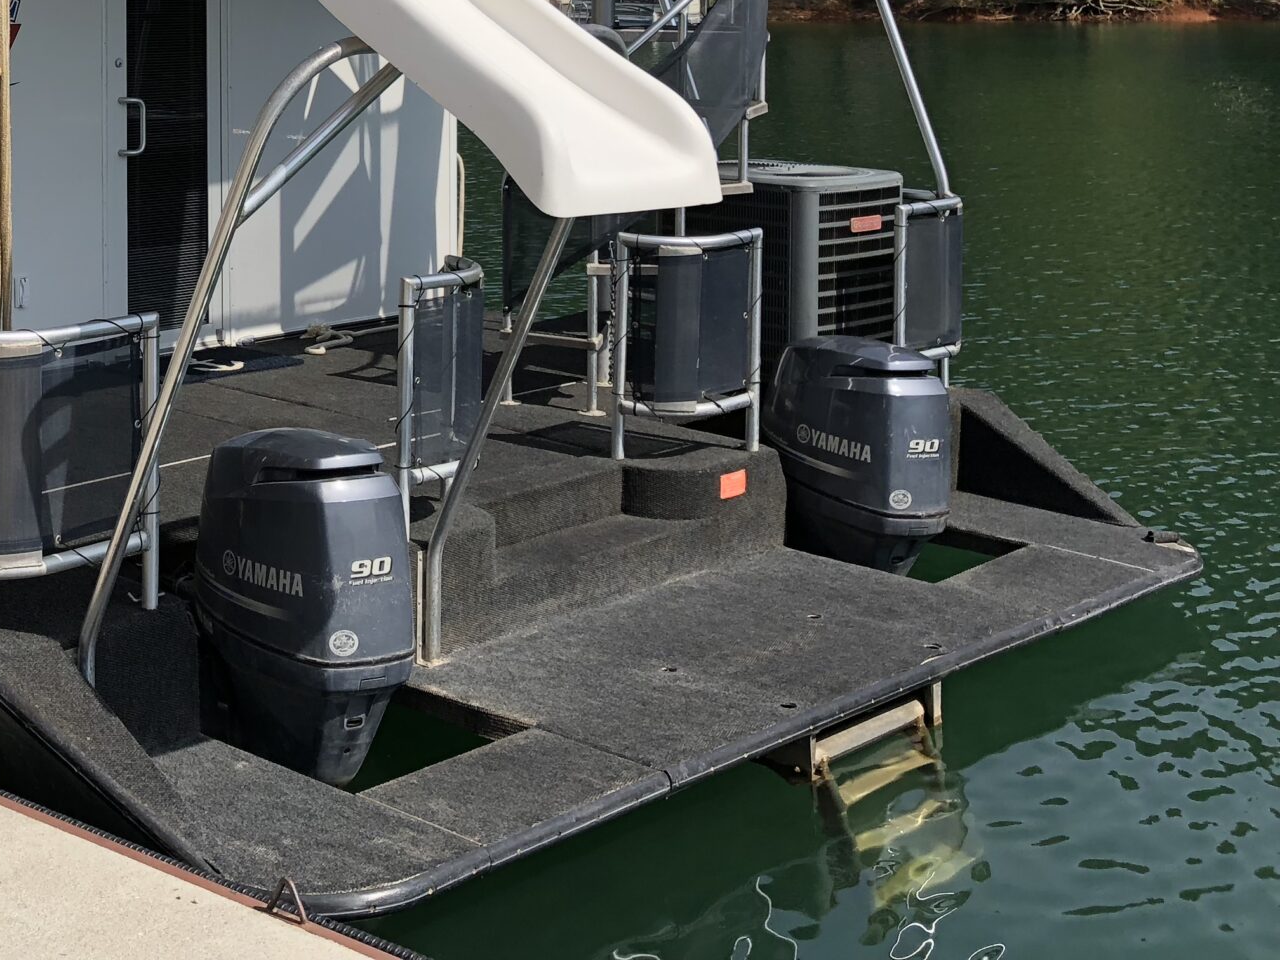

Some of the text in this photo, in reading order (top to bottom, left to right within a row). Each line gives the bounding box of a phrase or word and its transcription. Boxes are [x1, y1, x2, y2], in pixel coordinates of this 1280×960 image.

[812, 428, 871, 463] YAMAHA
[908, 438, 940, 453] 90
[237, 556, 304, 597] YAMAHA
[350, 556, 392, 579] 90
